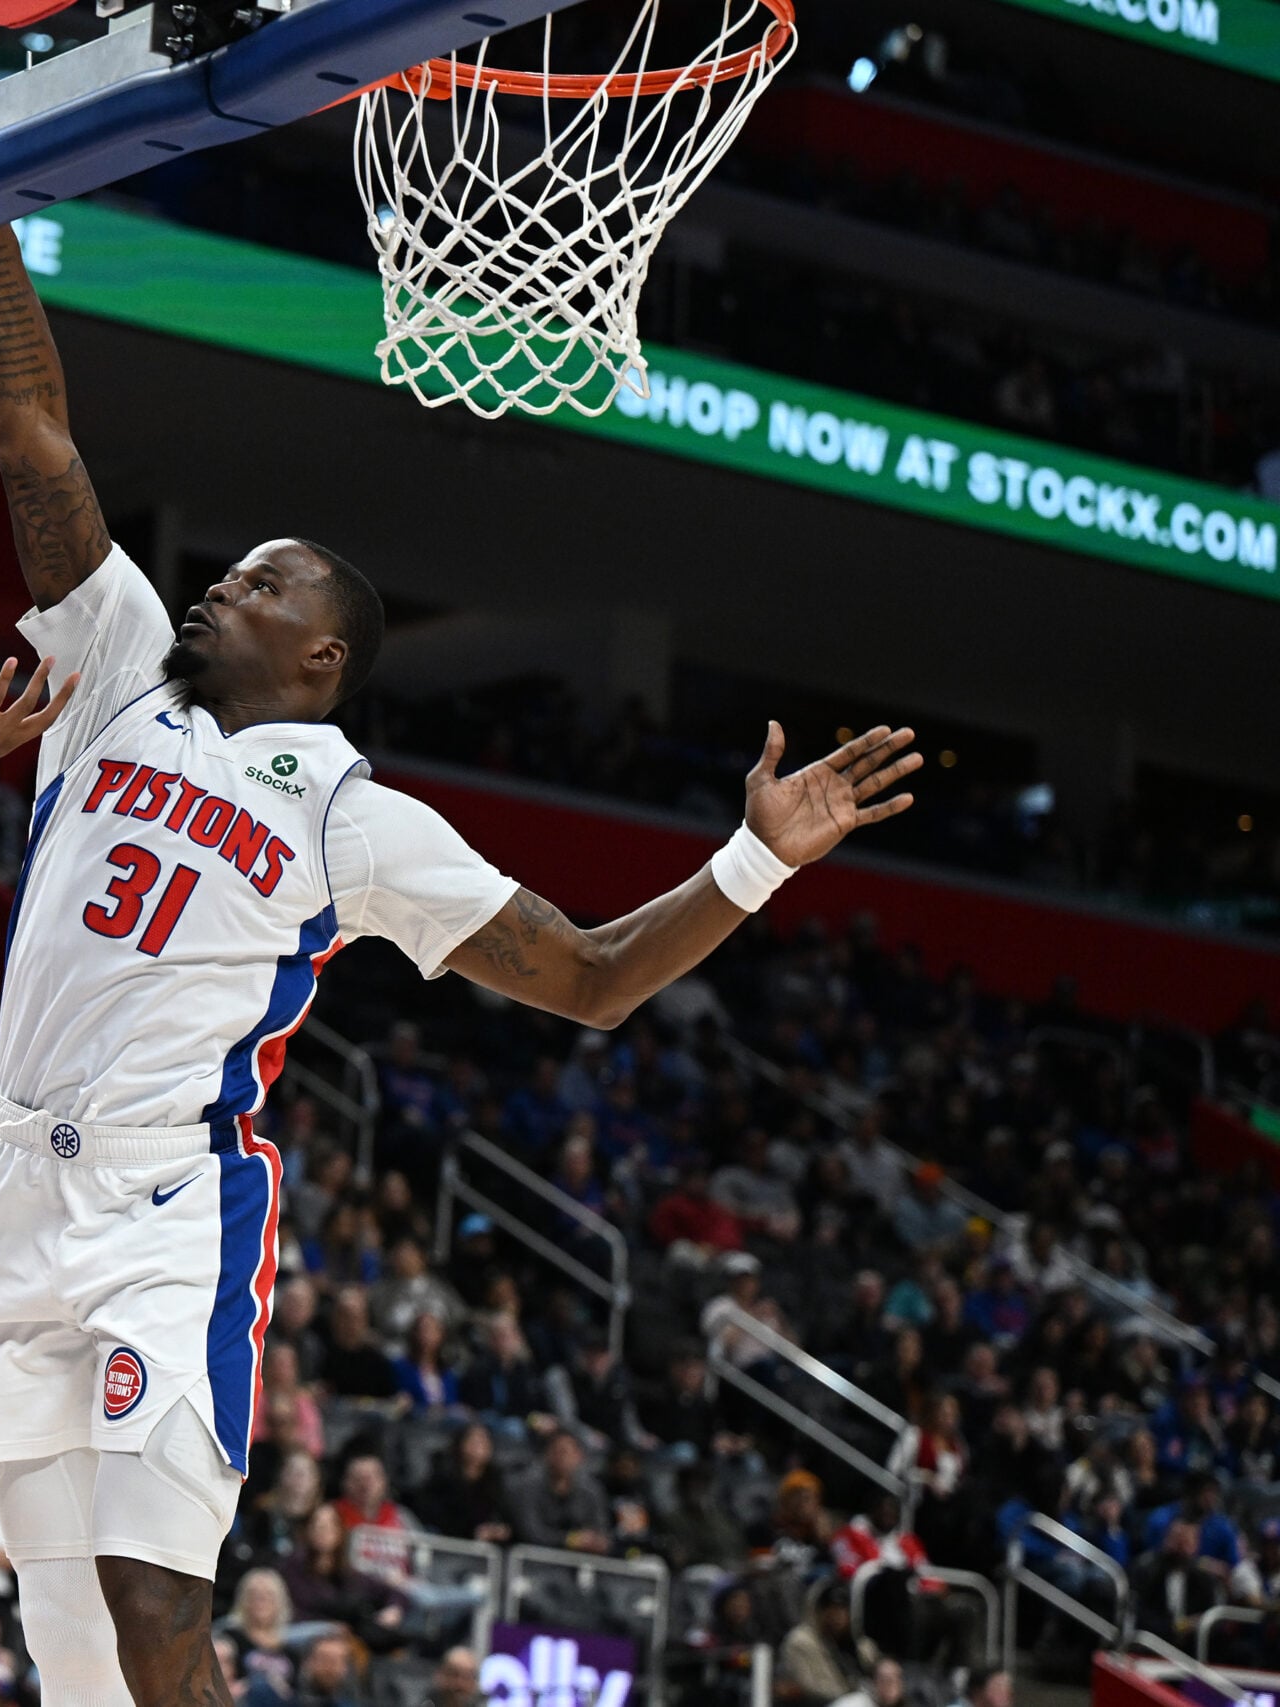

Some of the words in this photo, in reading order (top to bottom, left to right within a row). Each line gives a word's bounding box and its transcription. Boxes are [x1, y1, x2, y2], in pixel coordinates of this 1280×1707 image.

[11, 216, 64, 276] E
[615, 366, 760, 442] SHOP
[768, 401, 889, 476] NOW
[895, 434, 959, 493] AT
[967, 451, 1277, 573] STOCKX.COM
[81, 758, 296, 898] PISTONS
[82, 842, 202, 958] 31
[105, 1382, 133, 1398] PISTONS
[108, 1370, 136, 1386] DETROIT
